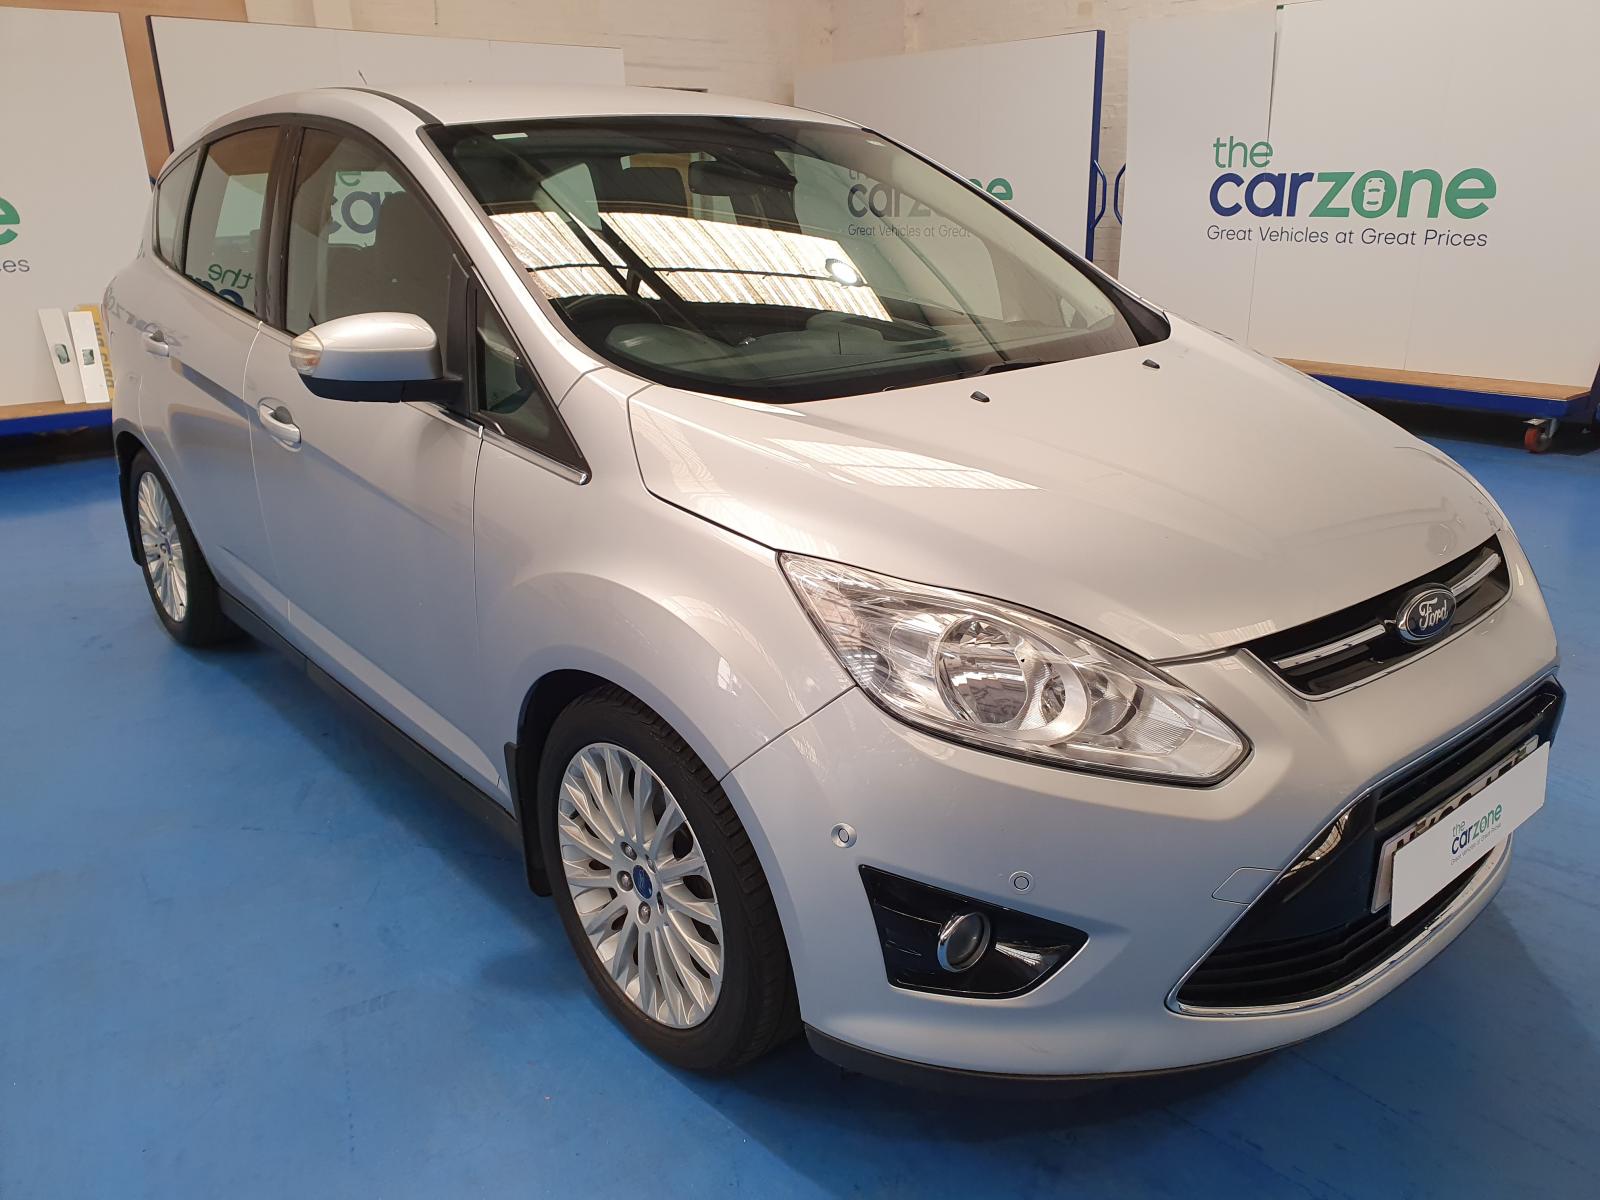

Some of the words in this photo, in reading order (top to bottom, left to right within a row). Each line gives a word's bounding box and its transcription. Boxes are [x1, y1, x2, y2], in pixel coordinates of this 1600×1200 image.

[1212, 135, 1274, 168] the
[1209, 167, 1497, 220] carzone
[848, 223, 876, 237] Great
[879, 223, 921, 238] Vehicles
[923, 225, 935, 237] at
[1206, 224, 1252, 241] Great
[1258, 226, 1329, 244] Vehicles
[1335, 229, 1354, 245] at
[1361, 227, 1417, 246] Great
[1424, 229, 1488, 247] Prices
[1418, 597, 1449, 631] Ford
